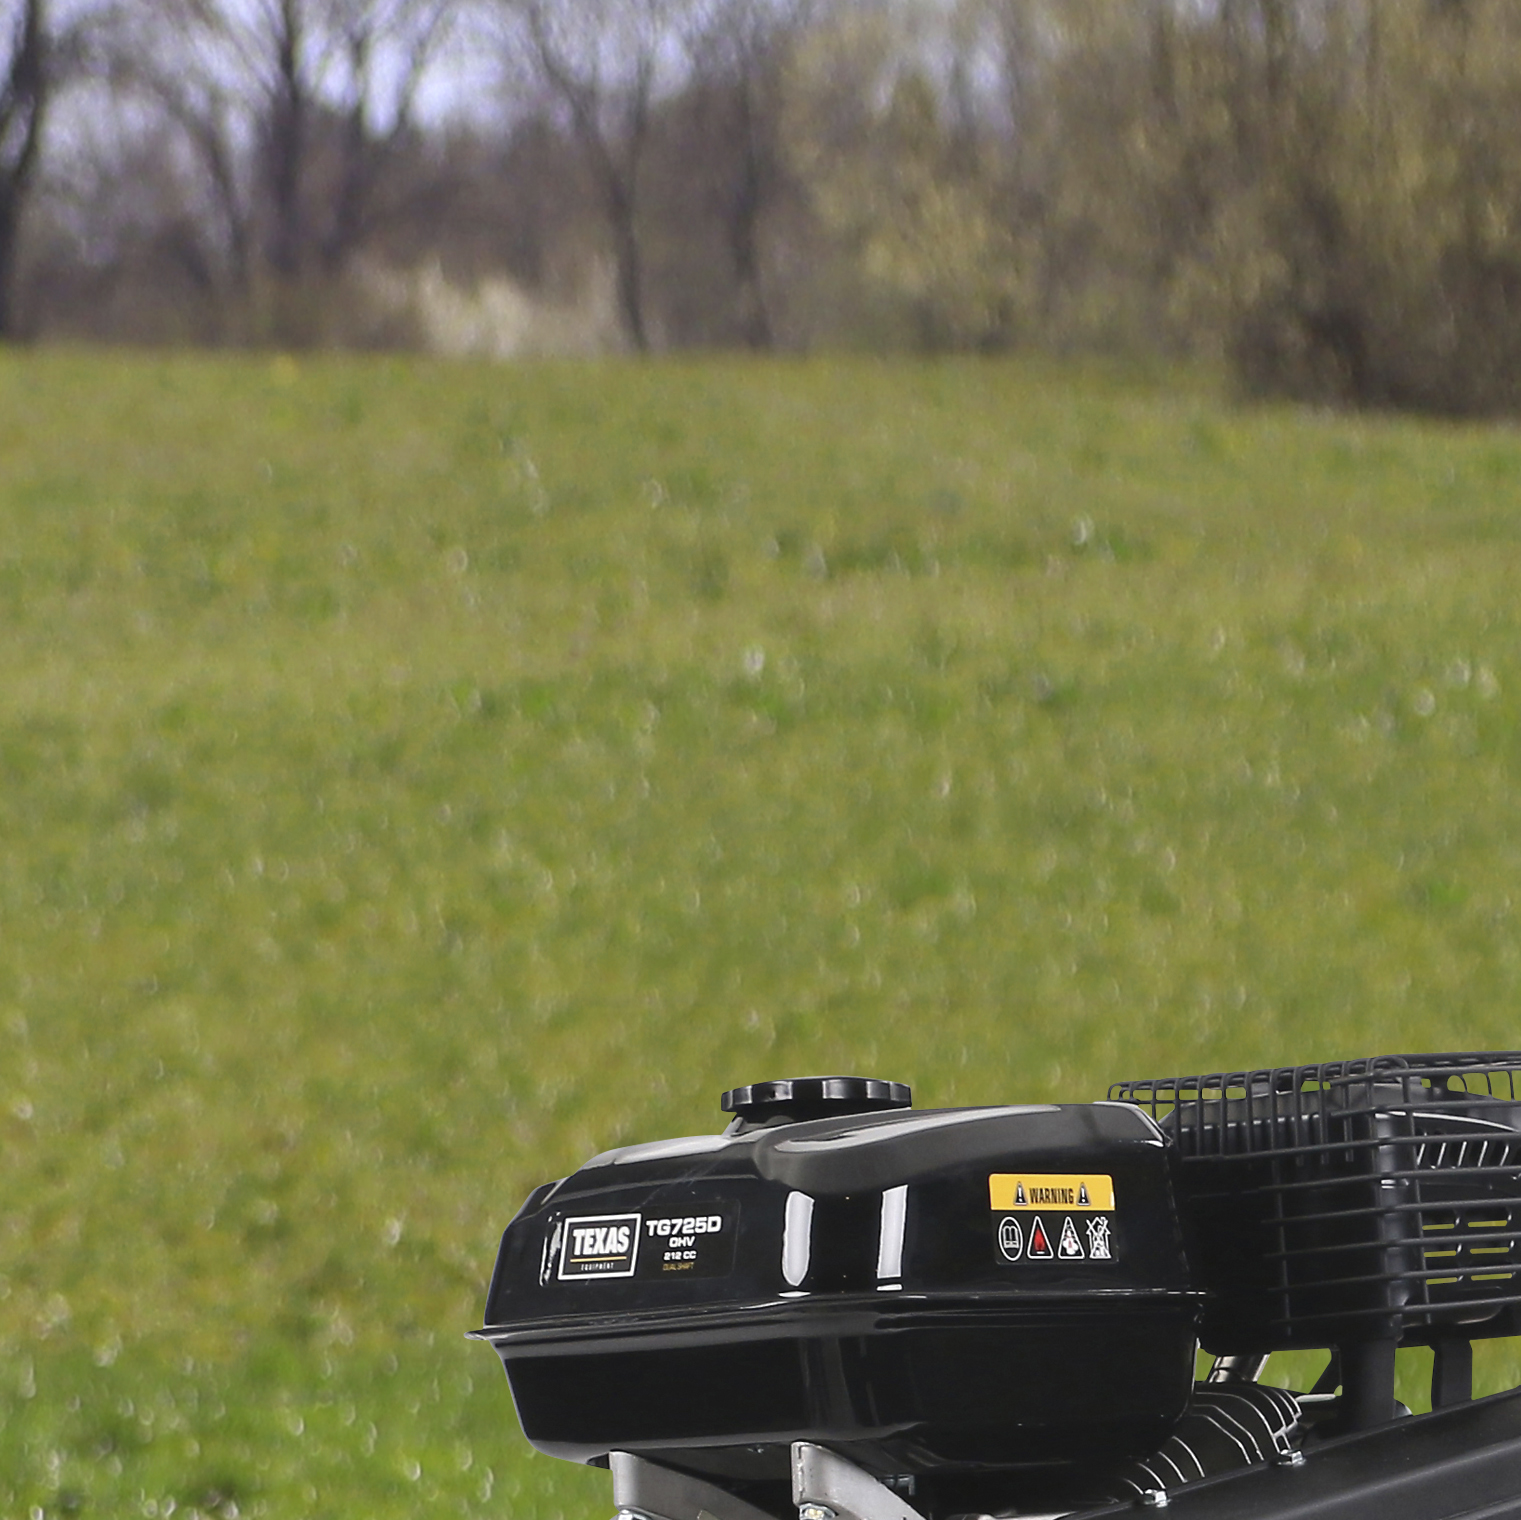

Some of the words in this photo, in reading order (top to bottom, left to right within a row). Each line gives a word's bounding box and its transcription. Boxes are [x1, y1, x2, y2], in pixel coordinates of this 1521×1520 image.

[1029, 1187, 1074, 1204] WARNING
[645, 1215, 722, 1236] TG725D
[572, 1226, 631, 1256] TEXAS
[669, 1236, 696, 1248] OHV
[663, 1252, 682, 1260] 212
[683, 1250, 697, 1259] CC
